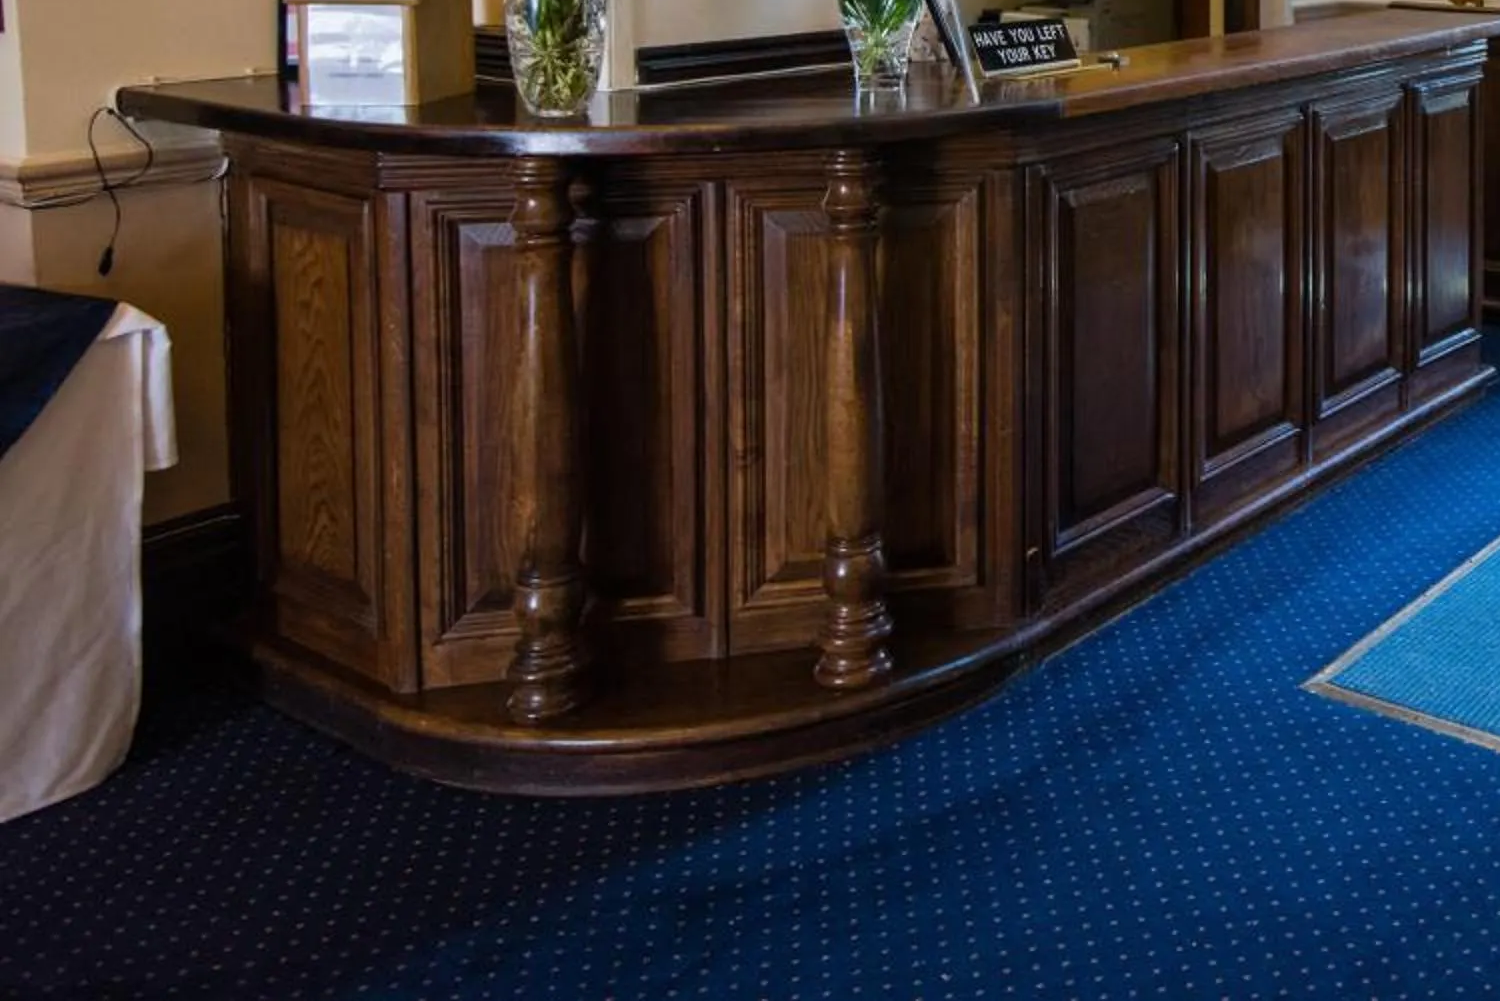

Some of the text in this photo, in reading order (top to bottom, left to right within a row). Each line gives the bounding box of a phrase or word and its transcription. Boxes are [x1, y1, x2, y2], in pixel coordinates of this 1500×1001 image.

[973, 24, 1065, 48] HAVE YOU LEFT
[997, 44, 1056, 65] YOUR KEY
